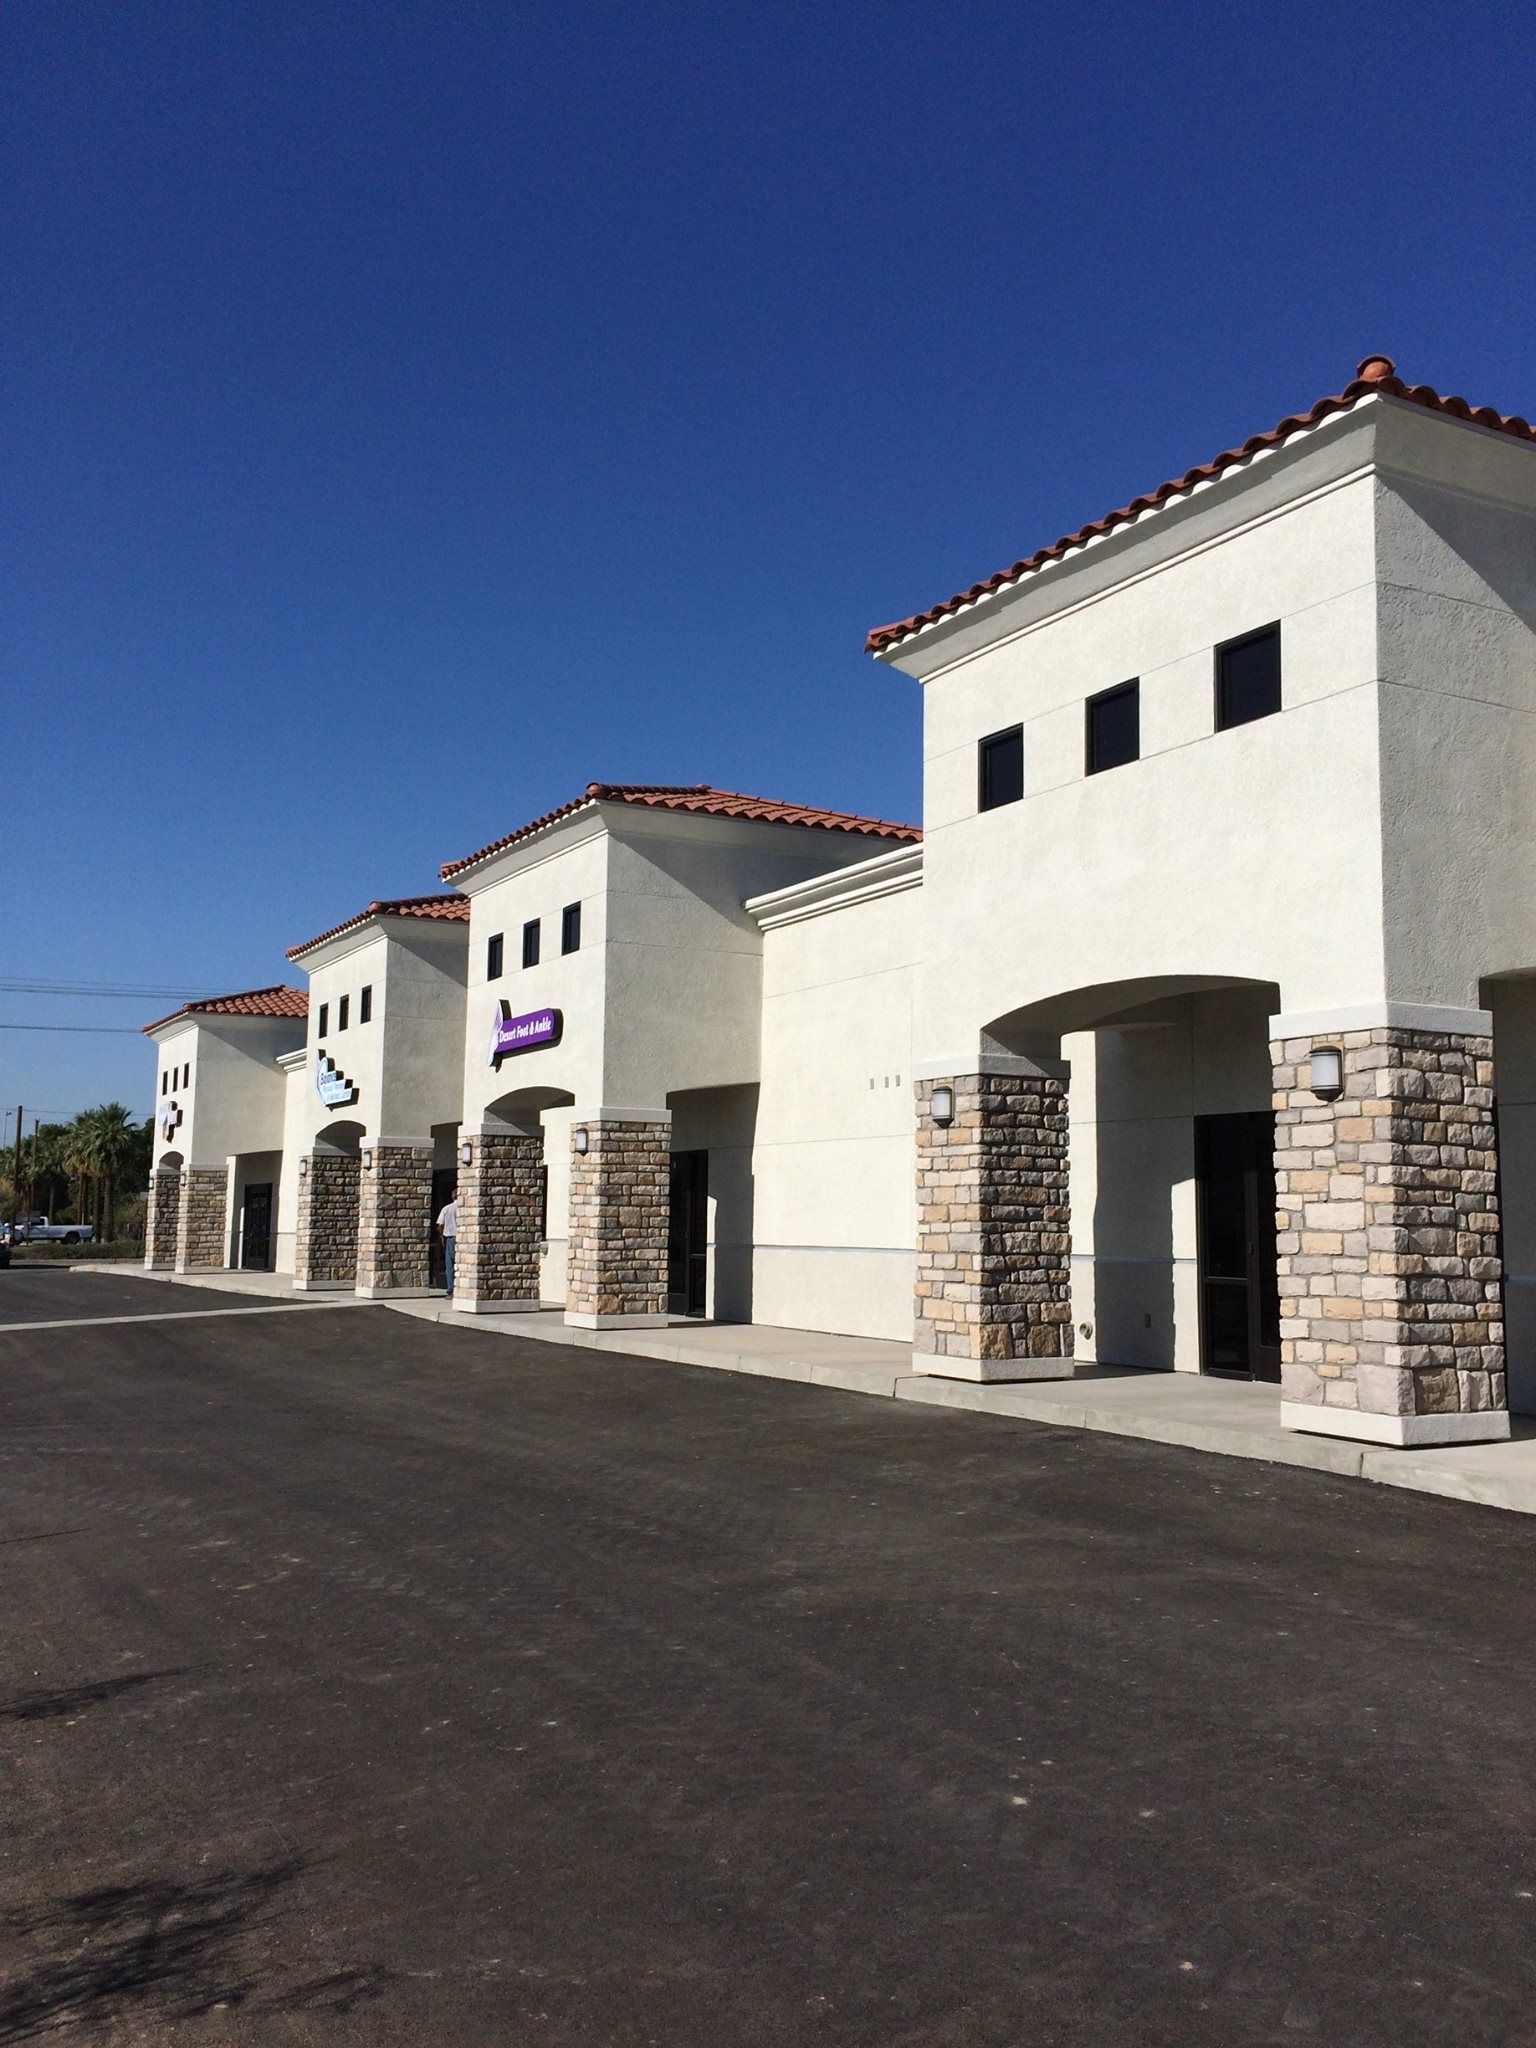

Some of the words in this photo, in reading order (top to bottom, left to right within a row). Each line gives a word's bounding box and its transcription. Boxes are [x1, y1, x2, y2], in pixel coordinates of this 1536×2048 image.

[517, 1024, 529, 1038] Foot
[530, 1021, 534, 1035] &
[535, 1016, 551, 1033] Ankle
